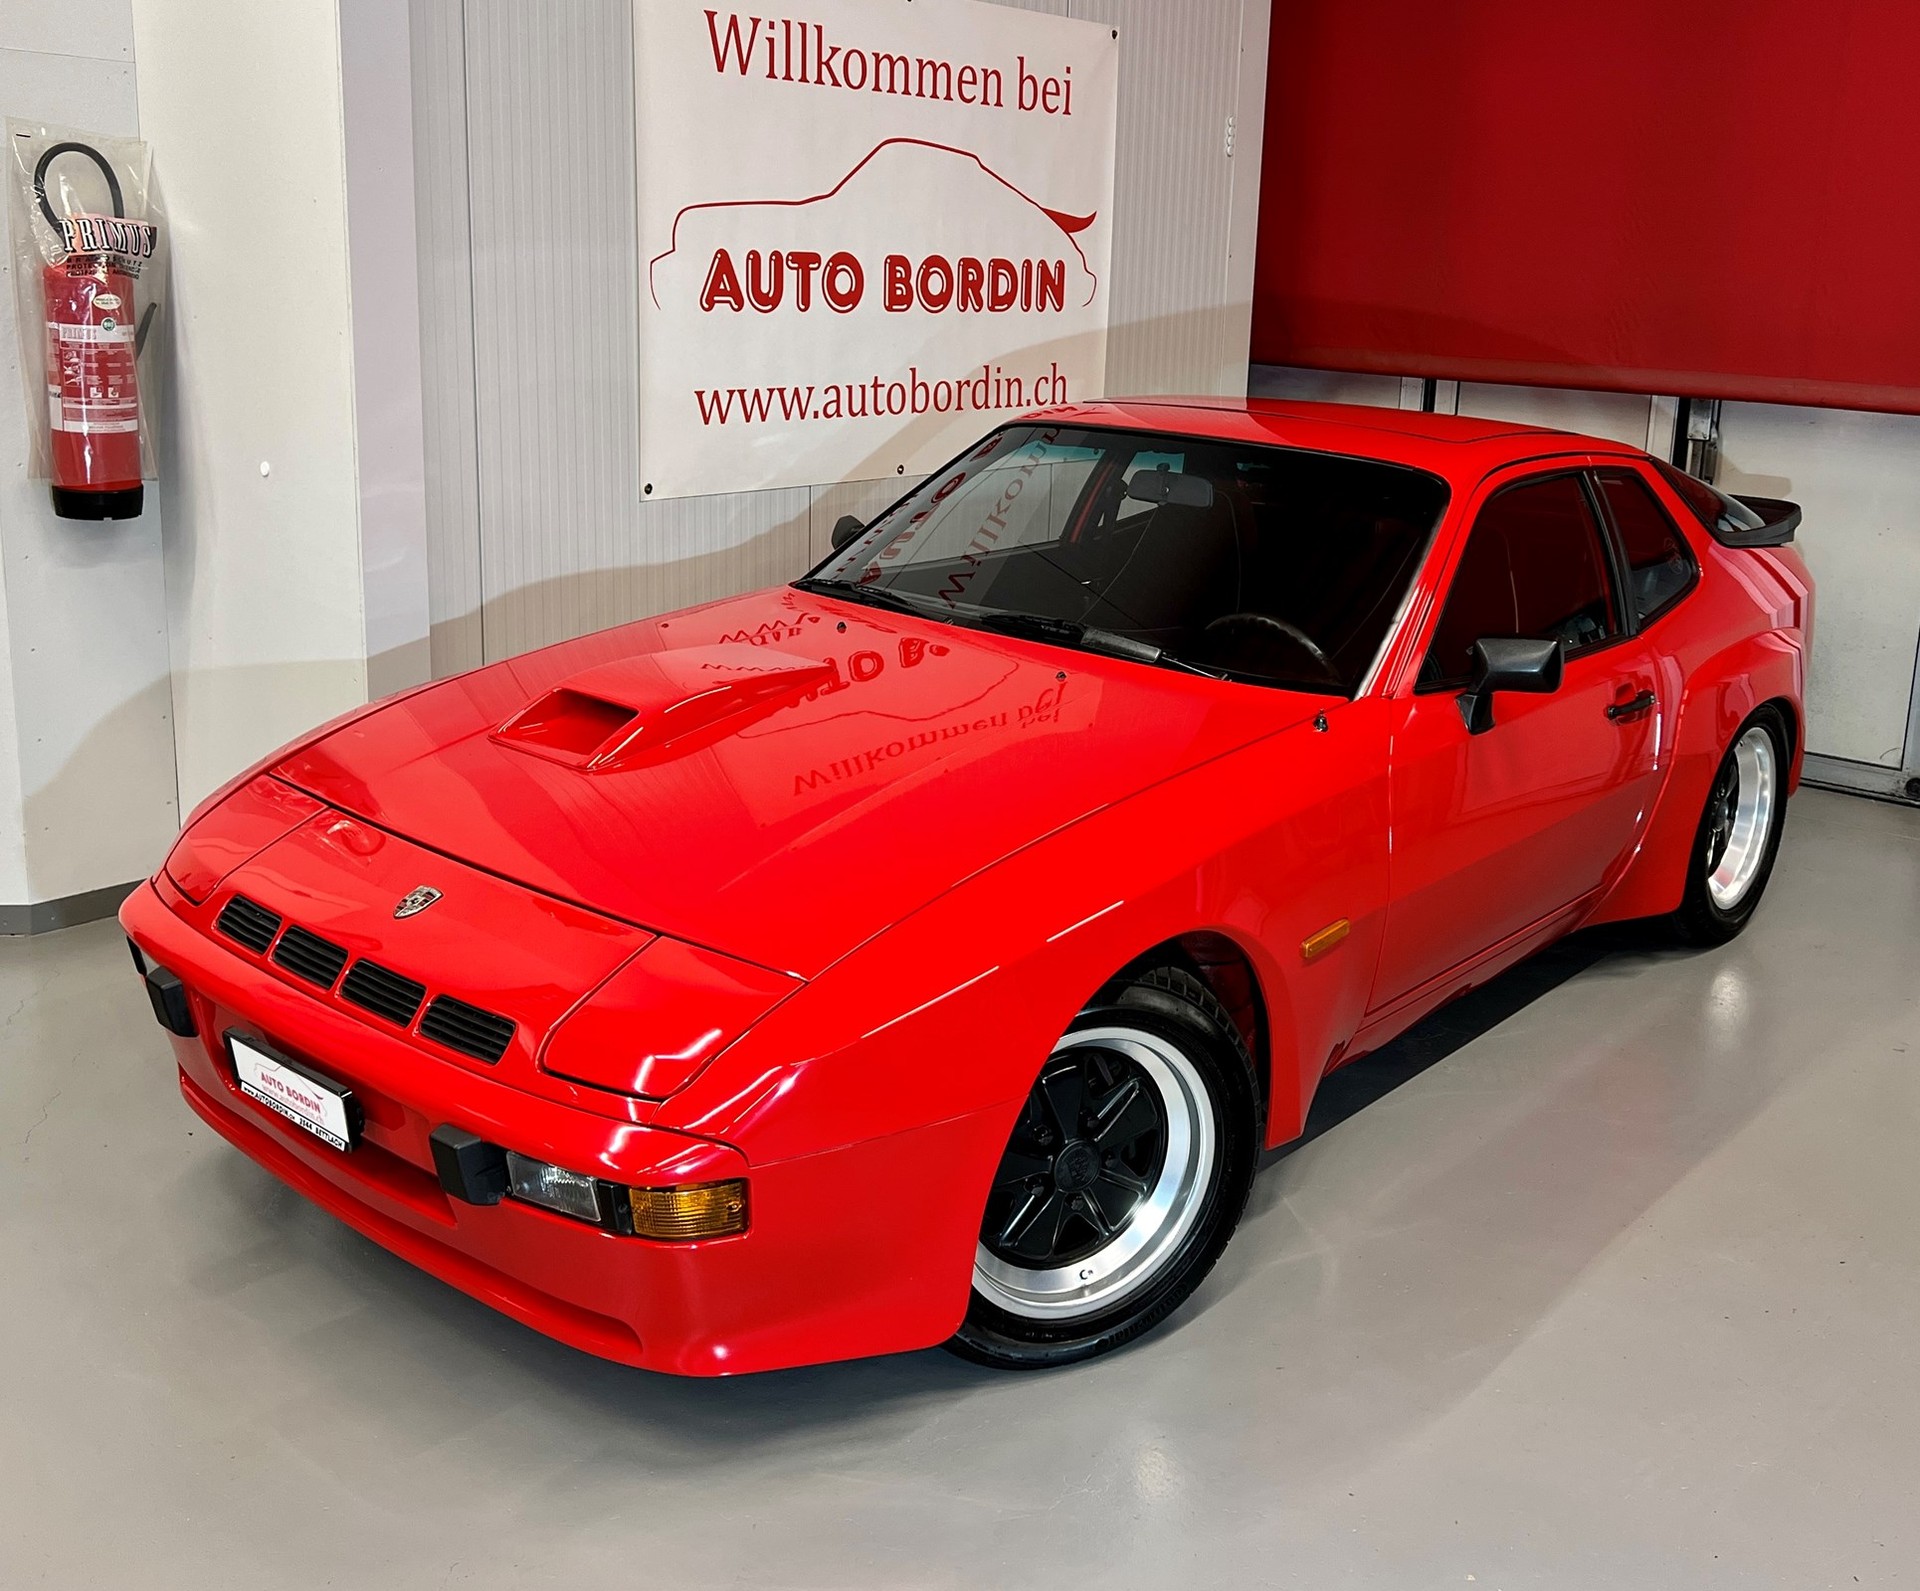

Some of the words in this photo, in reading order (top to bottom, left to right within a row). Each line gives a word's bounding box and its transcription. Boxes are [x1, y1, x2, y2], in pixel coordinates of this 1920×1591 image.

[704, 9, 1003, 108] Willkommen
[1017, 55, 1072, 116] bei
[59, 217, 152, 259] PRIMUS
[700, 247, 865, 314] AUTO
[883, 253, 1066, 314] BORDIN
[695, 362, 1068, 425] www.autobordin.ch
[260, 1072, 284, 1093] AUTO
[286, 1085, 321, 1114] BORDIN
